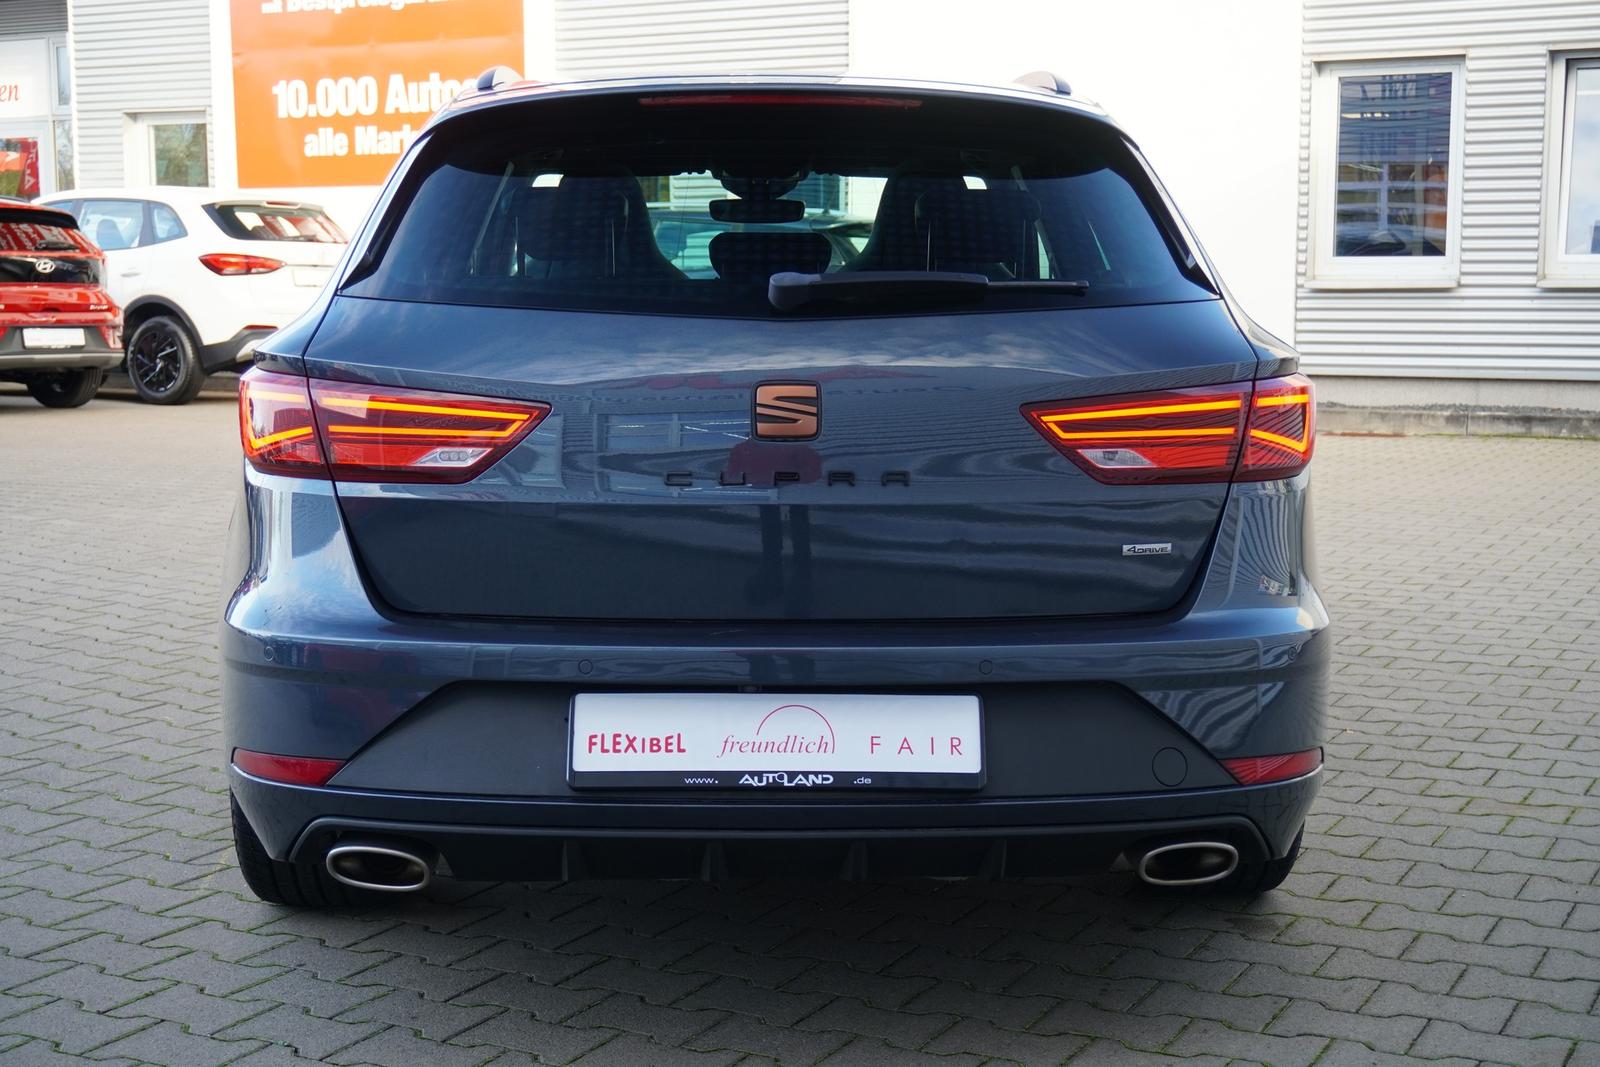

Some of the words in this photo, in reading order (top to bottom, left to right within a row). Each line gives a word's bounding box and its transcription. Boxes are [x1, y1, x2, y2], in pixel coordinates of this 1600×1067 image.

[272, 76, 379, 119] 10.000
[304, 127, 349, 157] alle
[664, 470, 912, 487] CUPRA
[587, 732, 687, 754] FLEXIBEL
[717, 734, 829, 758] freundlich
